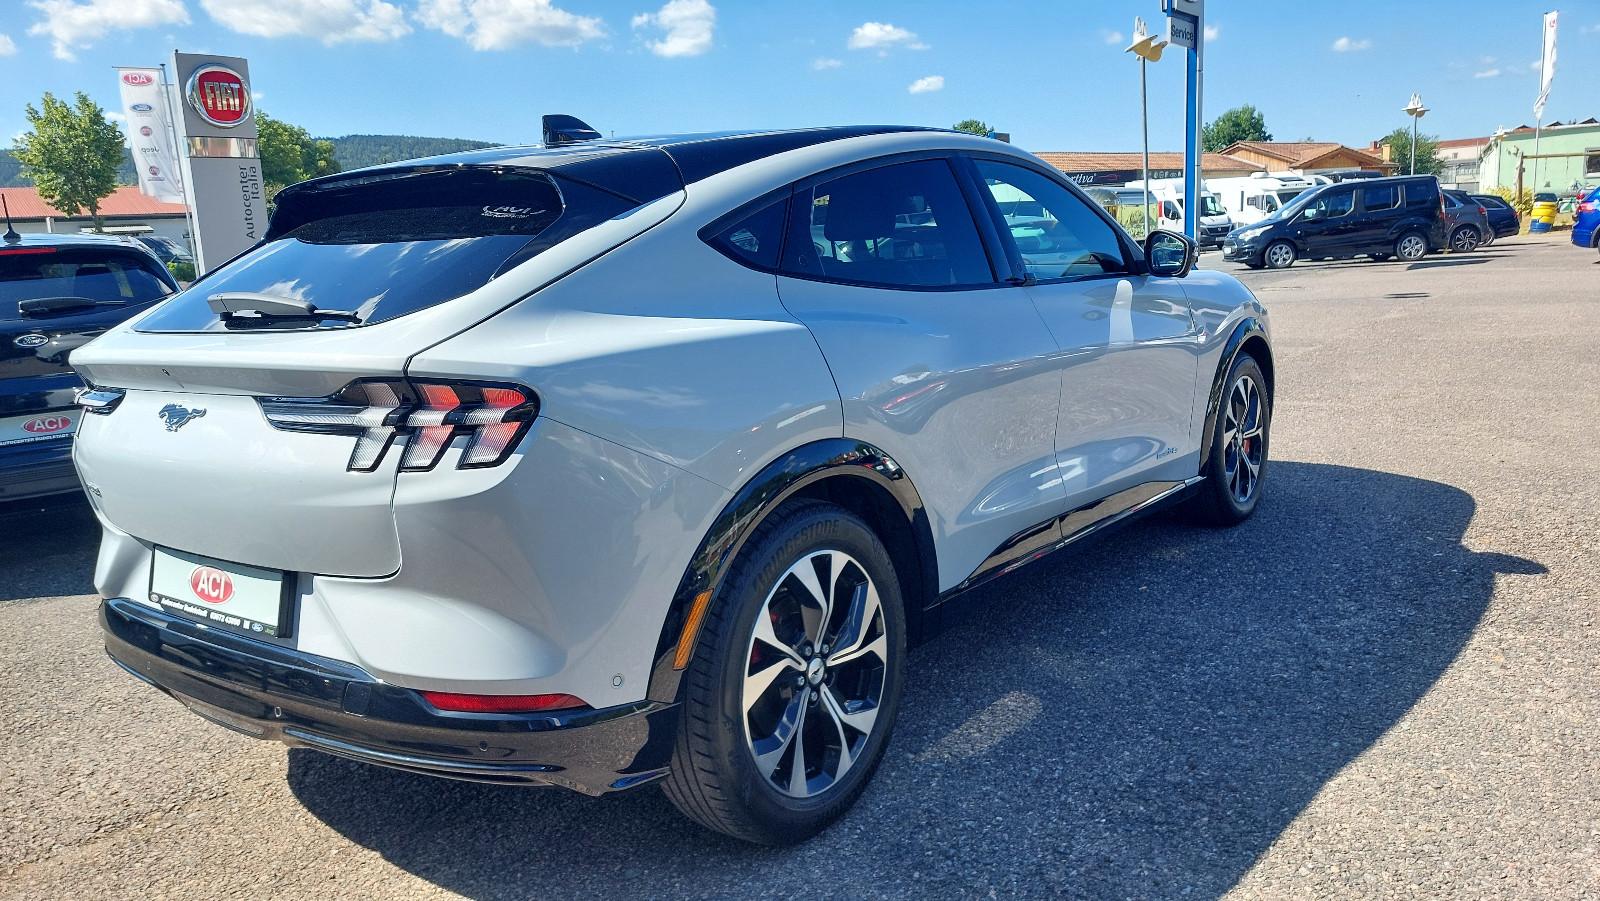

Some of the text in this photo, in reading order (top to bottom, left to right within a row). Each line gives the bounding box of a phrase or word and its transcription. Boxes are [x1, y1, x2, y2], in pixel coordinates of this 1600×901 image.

[1171, 24, 1194, 42] Service
[204, 82, 241, 111] FIAT
[249, 166, 260, 200] Italia
[239, 165, 256, 239] Autocenter
[33, 417, 63, 431] ACI
[753, 519, 841, 594] BRIDGESTONE
[197, 570, 226, 599] ACI
